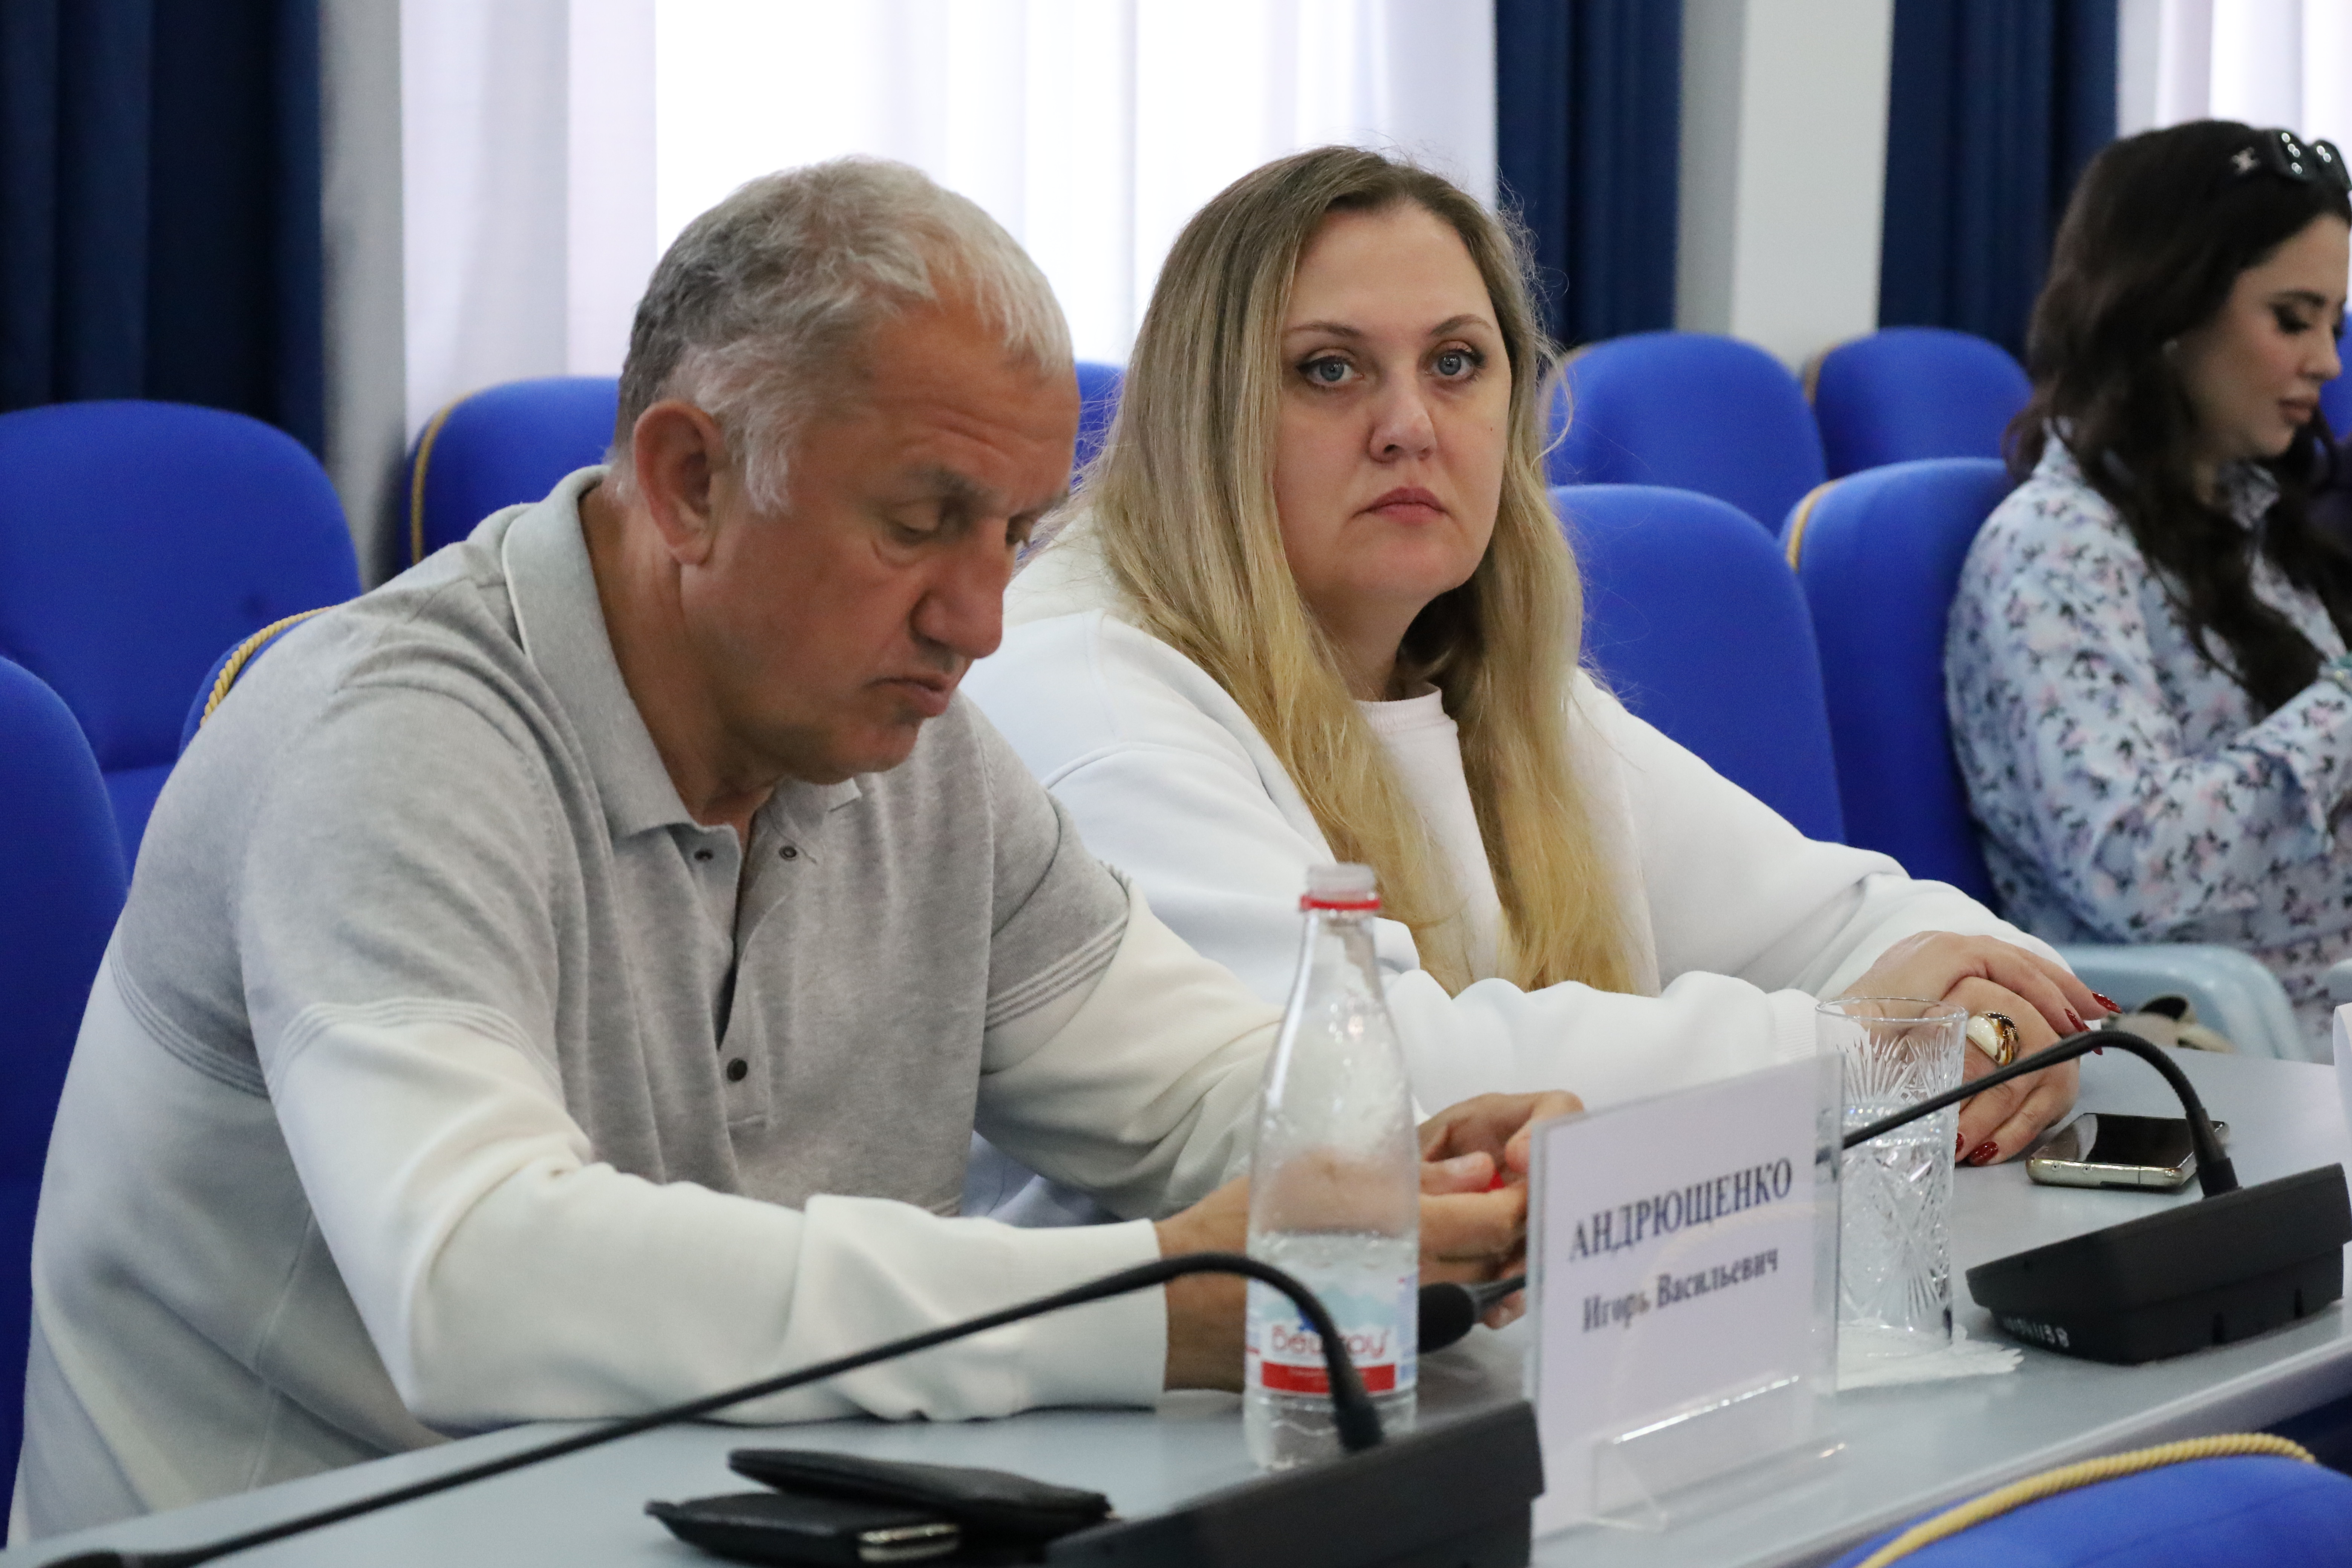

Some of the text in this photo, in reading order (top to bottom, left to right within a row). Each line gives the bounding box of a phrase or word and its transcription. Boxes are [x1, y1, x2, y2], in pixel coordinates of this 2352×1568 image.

[1569, 1156, 1793, 1263] АНДРЮЩЕНКО
[1583, 1248, 1778, 1333] Игорь Васильевич
